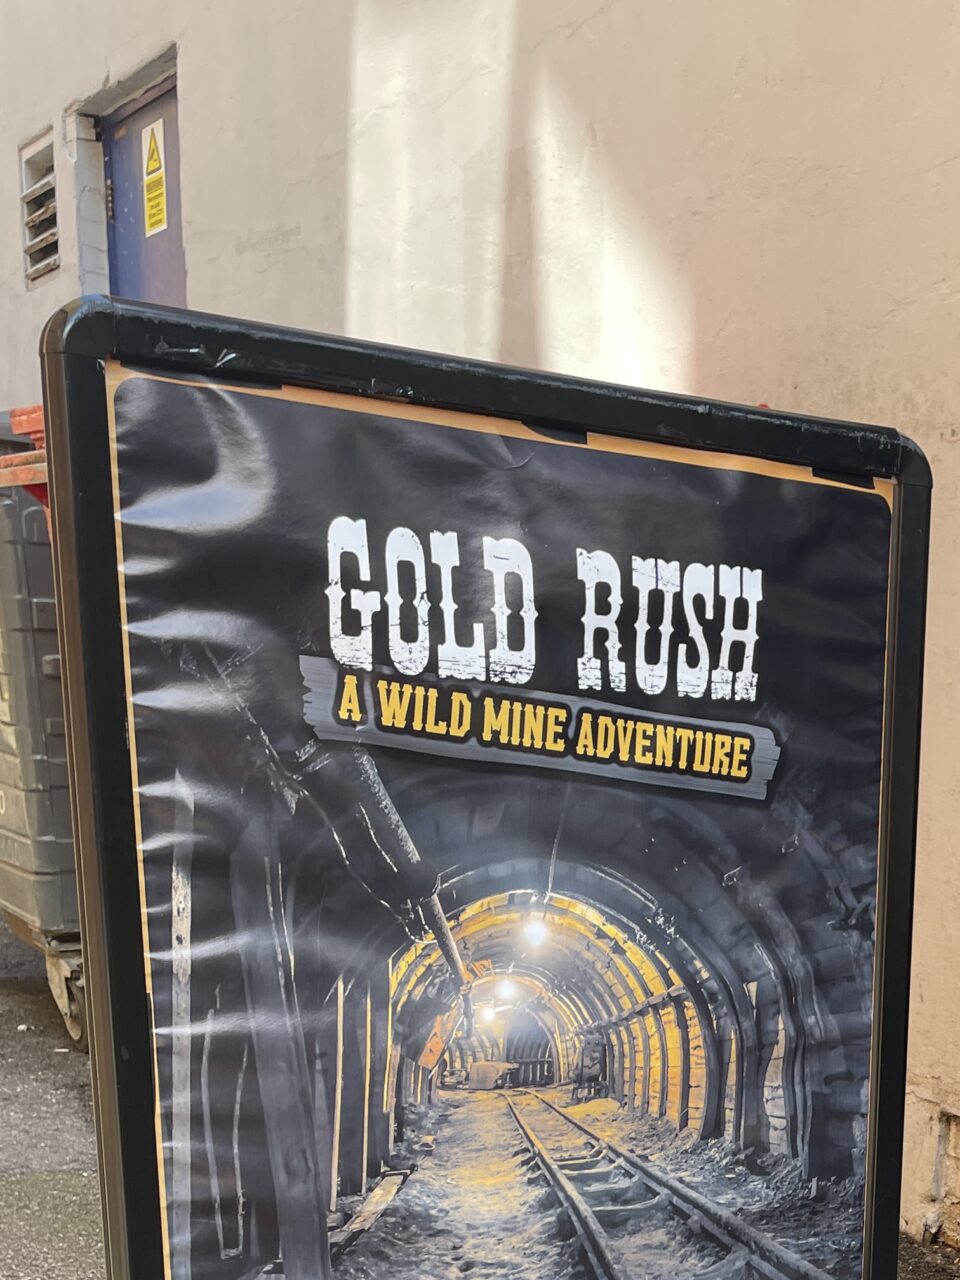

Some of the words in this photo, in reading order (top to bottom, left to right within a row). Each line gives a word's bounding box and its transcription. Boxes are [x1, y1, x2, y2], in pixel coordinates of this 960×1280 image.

[324, 516, 538, 685] GOLD
[576, 547, 763, 702] RUSH
[338, 674, 363, 722] A
[377, 678, 472, 738] WILD
[482, 695, 568, 752] MINE
[575, 711, 752, 779] ADVENTURE
